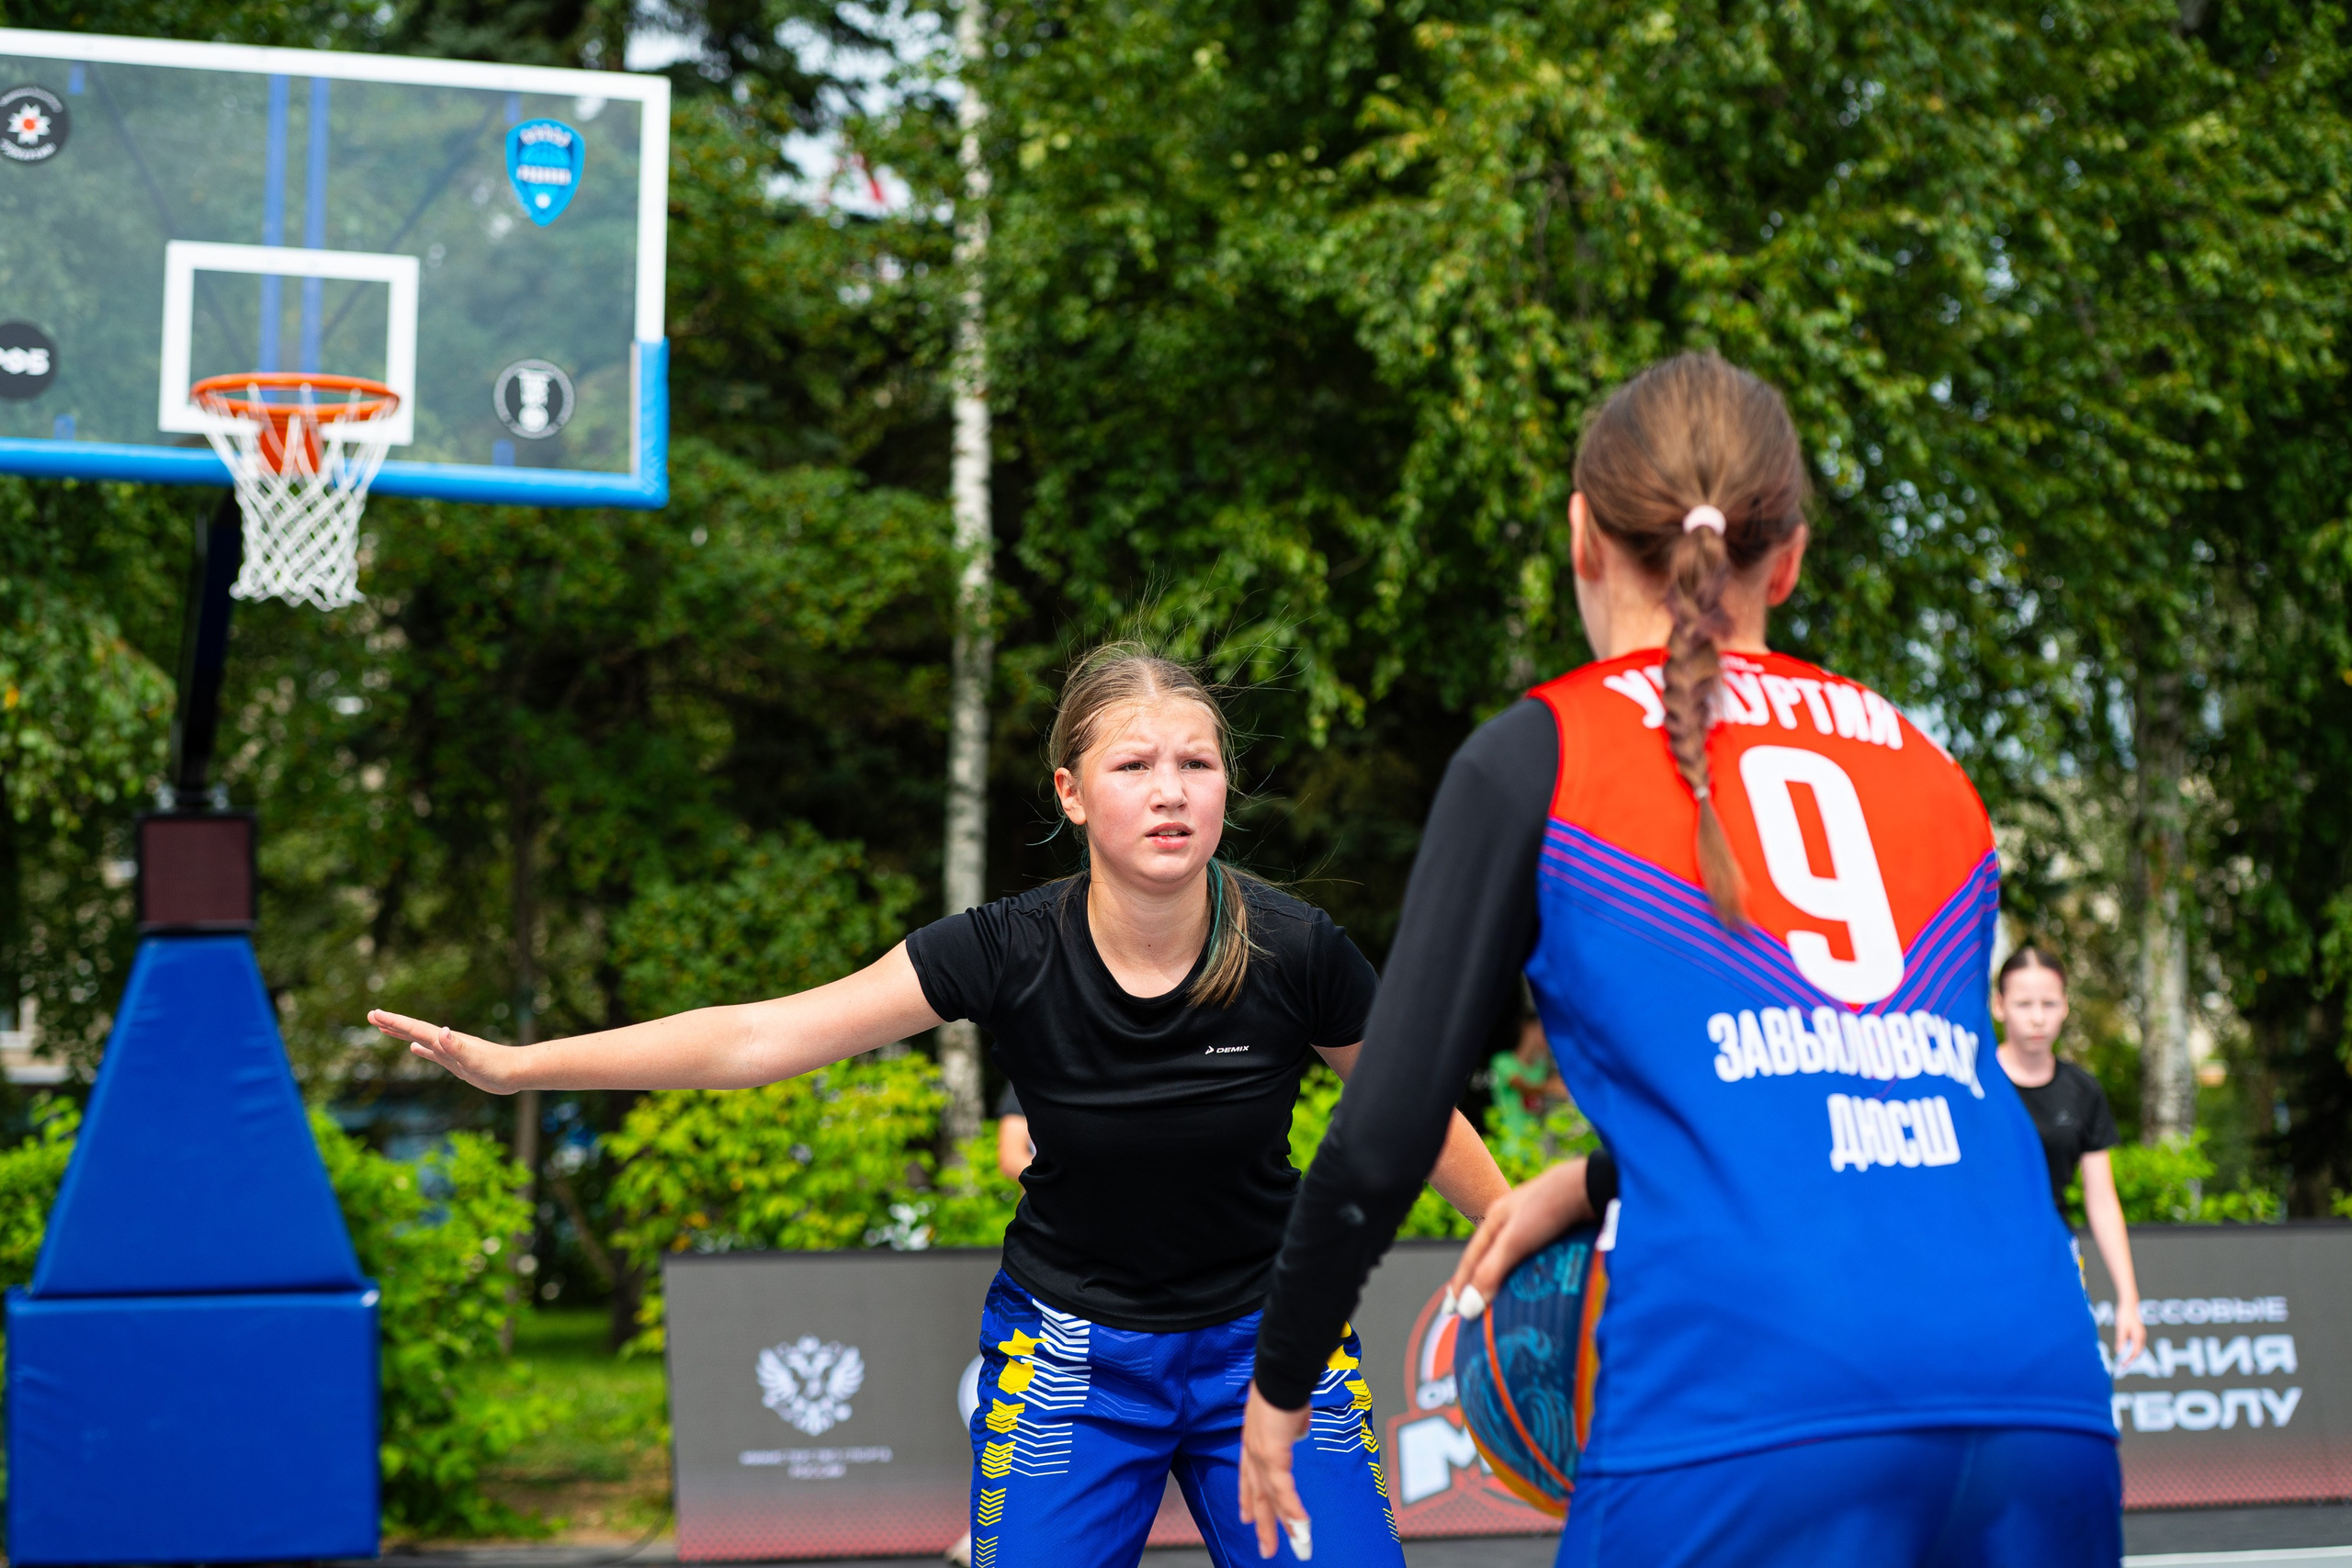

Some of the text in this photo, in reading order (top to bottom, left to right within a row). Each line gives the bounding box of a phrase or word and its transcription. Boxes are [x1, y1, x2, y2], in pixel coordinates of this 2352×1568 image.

[0, 346, 50, 376] ФБ
[1602, 665, 1904, 750] УУРТИЯ
[1739, 744, 1905, 1004] 9
[1216, 1045, 1250, 1054] DEMIX
[1826, 1093, 1962, 1173] ДЮСШ
[2088, 1296, 2290, 1325] МССОВЫЕ
